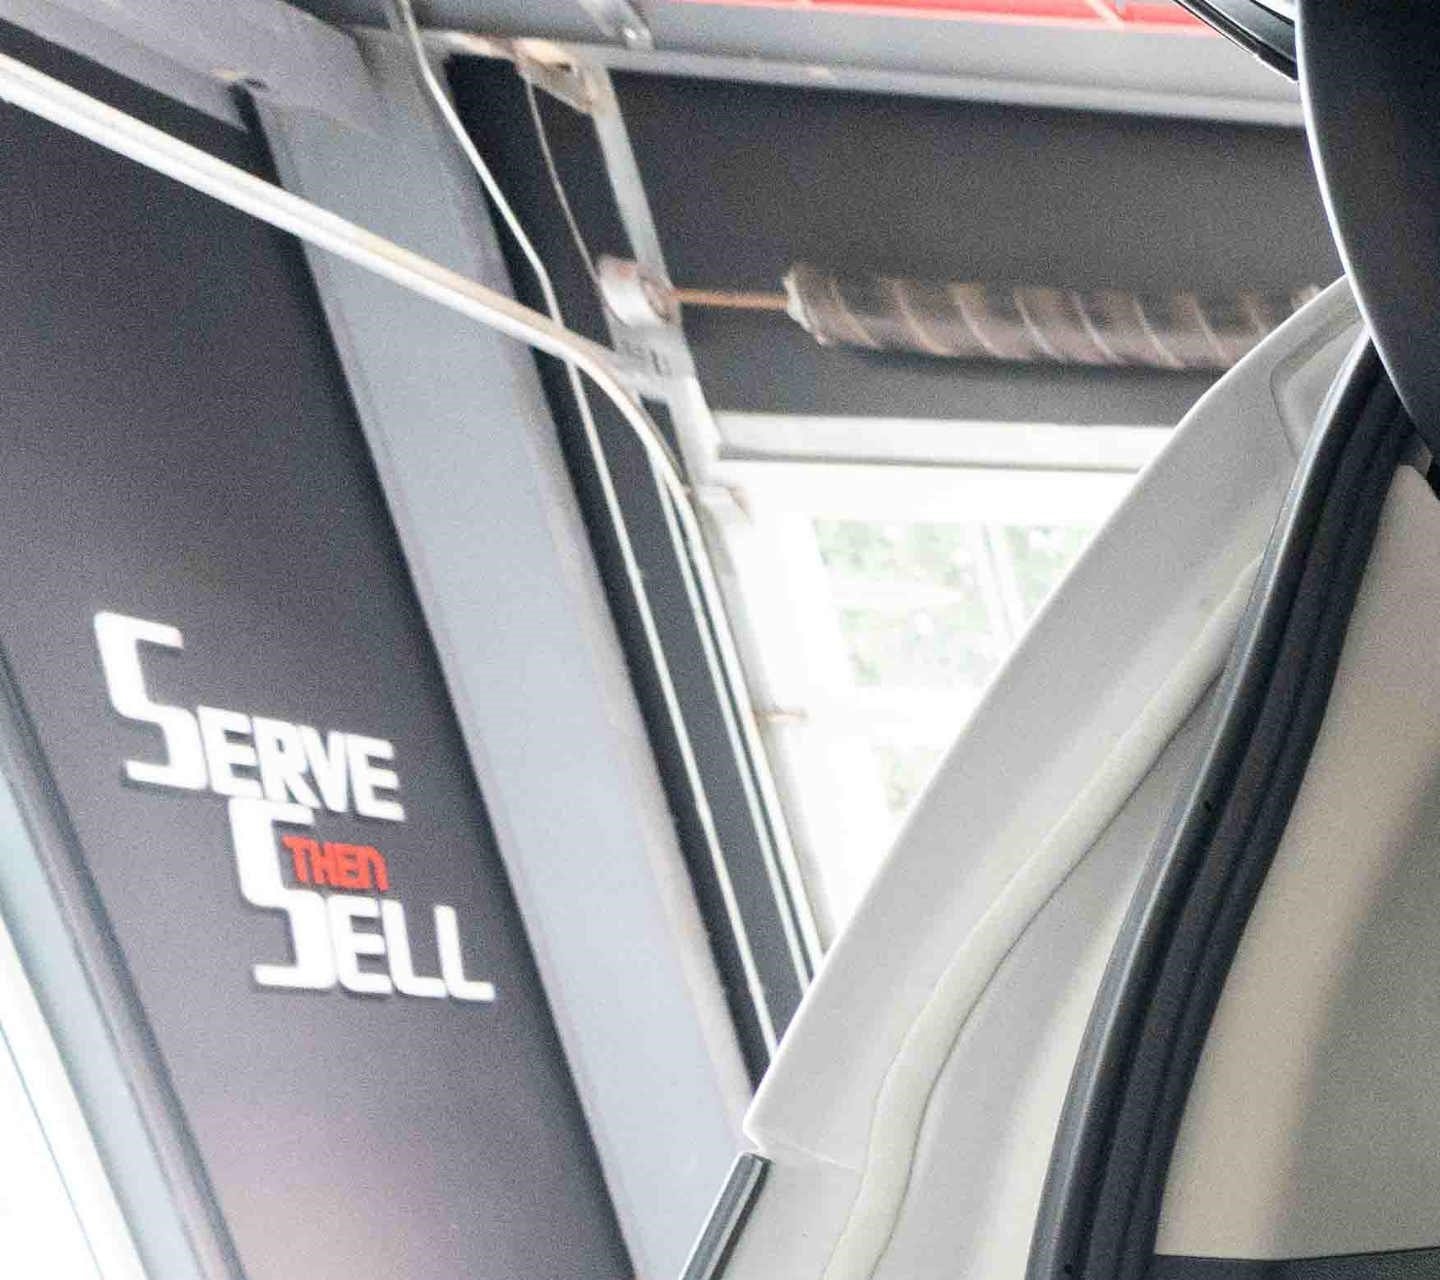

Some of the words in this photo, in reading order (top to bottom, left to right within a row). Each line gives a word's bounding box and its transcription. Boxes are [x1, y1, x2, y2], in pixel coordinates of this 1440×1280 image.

[94, 612, 405, 821] SERVE
[229, 797, 494, 1002] SELL
[282, 836, 389, 891] THEN
